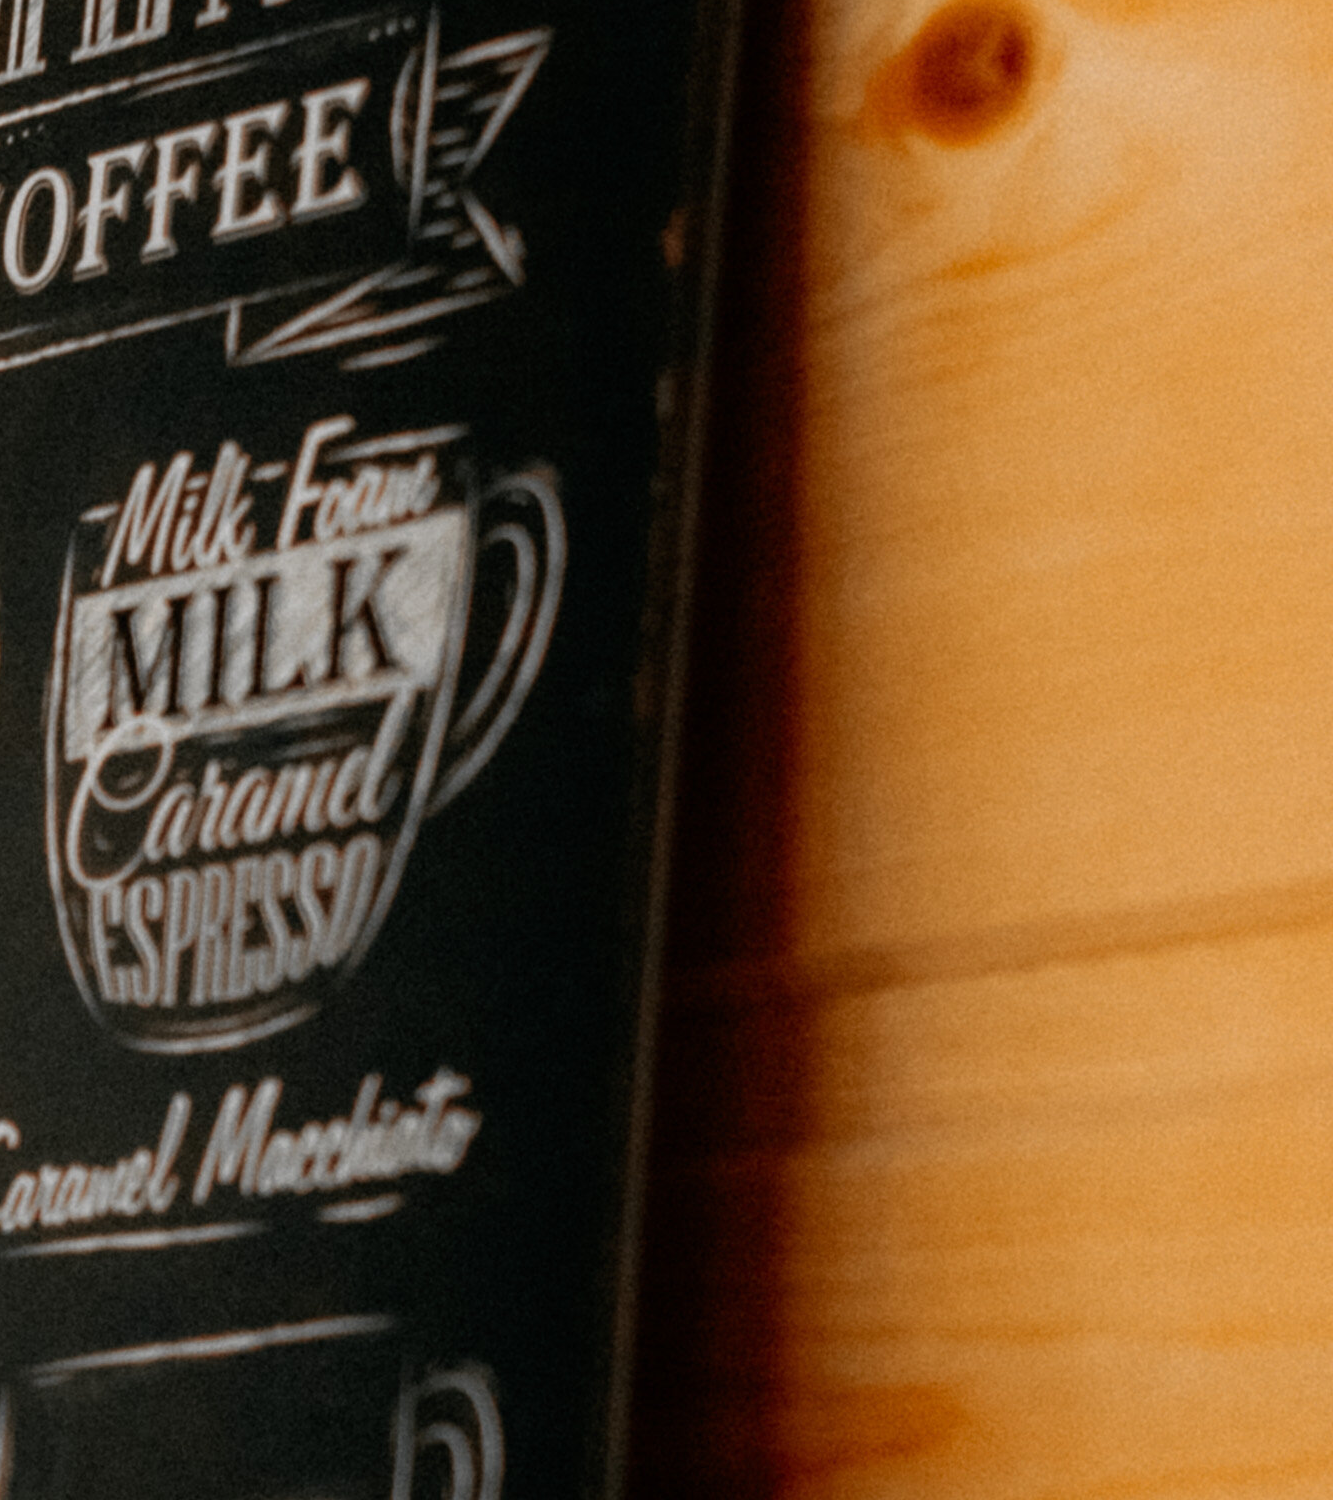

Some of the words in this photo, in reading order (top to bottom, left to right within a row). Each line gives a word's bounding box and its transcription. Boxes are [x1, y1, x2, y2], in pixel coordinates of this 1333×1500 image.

[100, 440, 256, 588] Milk
[277, 414, 441, 550] Foam
[102, 543, 419, 730] MILK
[67, 688, 416, 890] Caramel
[87, 833, 383, 1009] ESPRESSO
[191, 1066, 482, 1206] Macchiato
